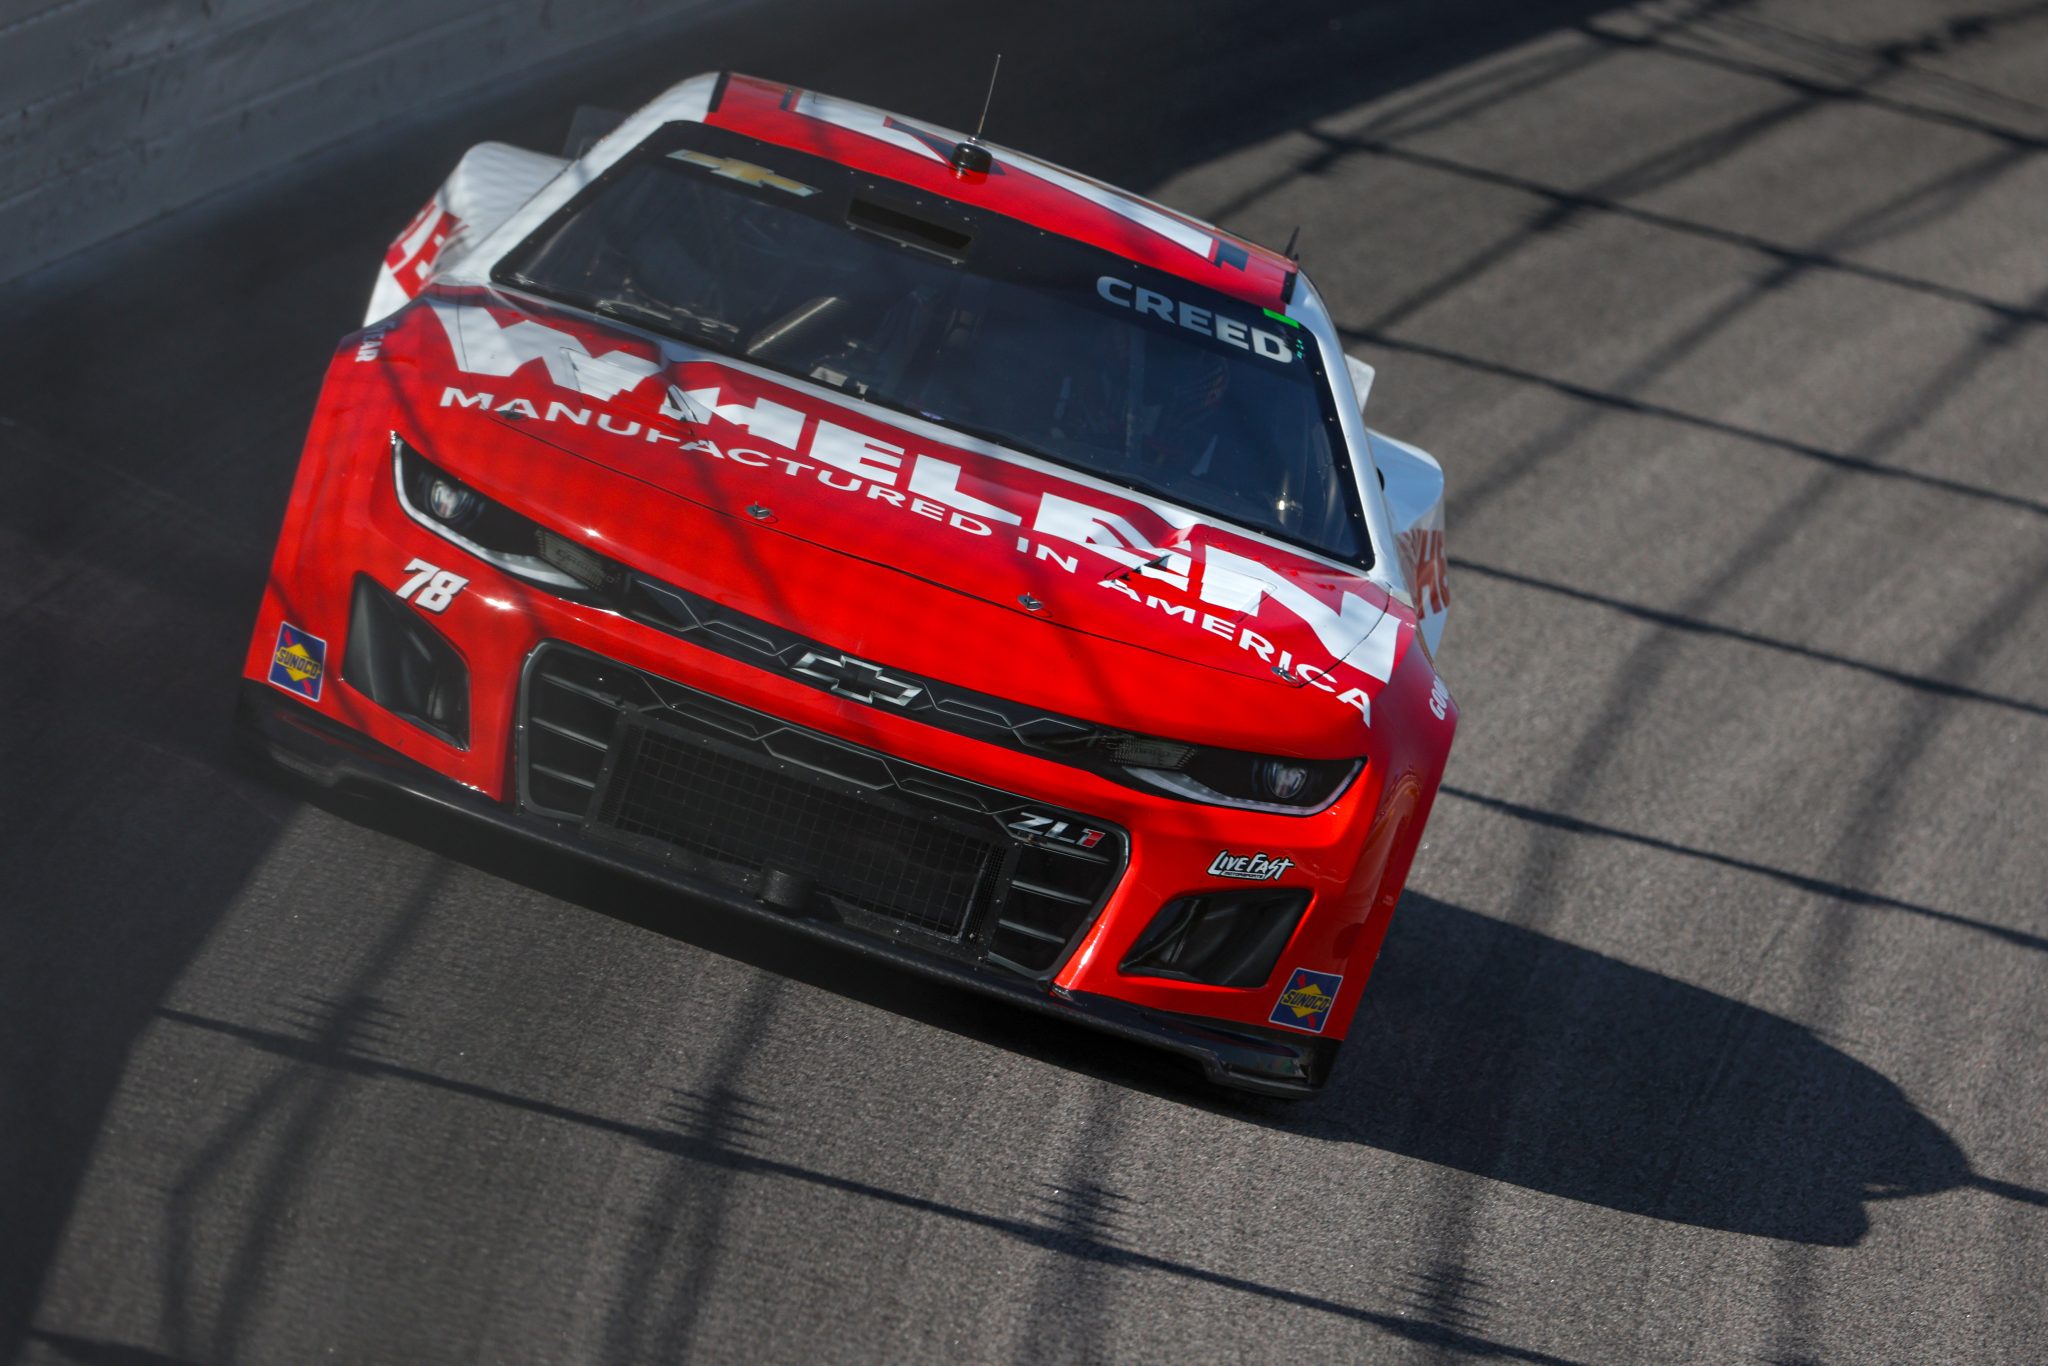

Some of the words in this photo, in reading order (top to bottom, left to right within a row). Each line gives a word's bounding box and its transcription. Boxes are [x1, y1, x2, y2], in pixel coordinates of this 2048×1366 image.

[1096, 276, 1292, 363] CREED
[426, 300, 1402, 685] WHELEN
[395, 557, 469, 613] 78
[440, 386, 992, 537] MANUFACTURED
[1016, 536, 1079, 574] IN
[1097, 578, 1371, 728] AMERICA
[276, 649, 321, 678] SUNOCO
[1007, 811, 1106, 848] ZL1
[1281, 989, 1331, 1012] SUNOCO
